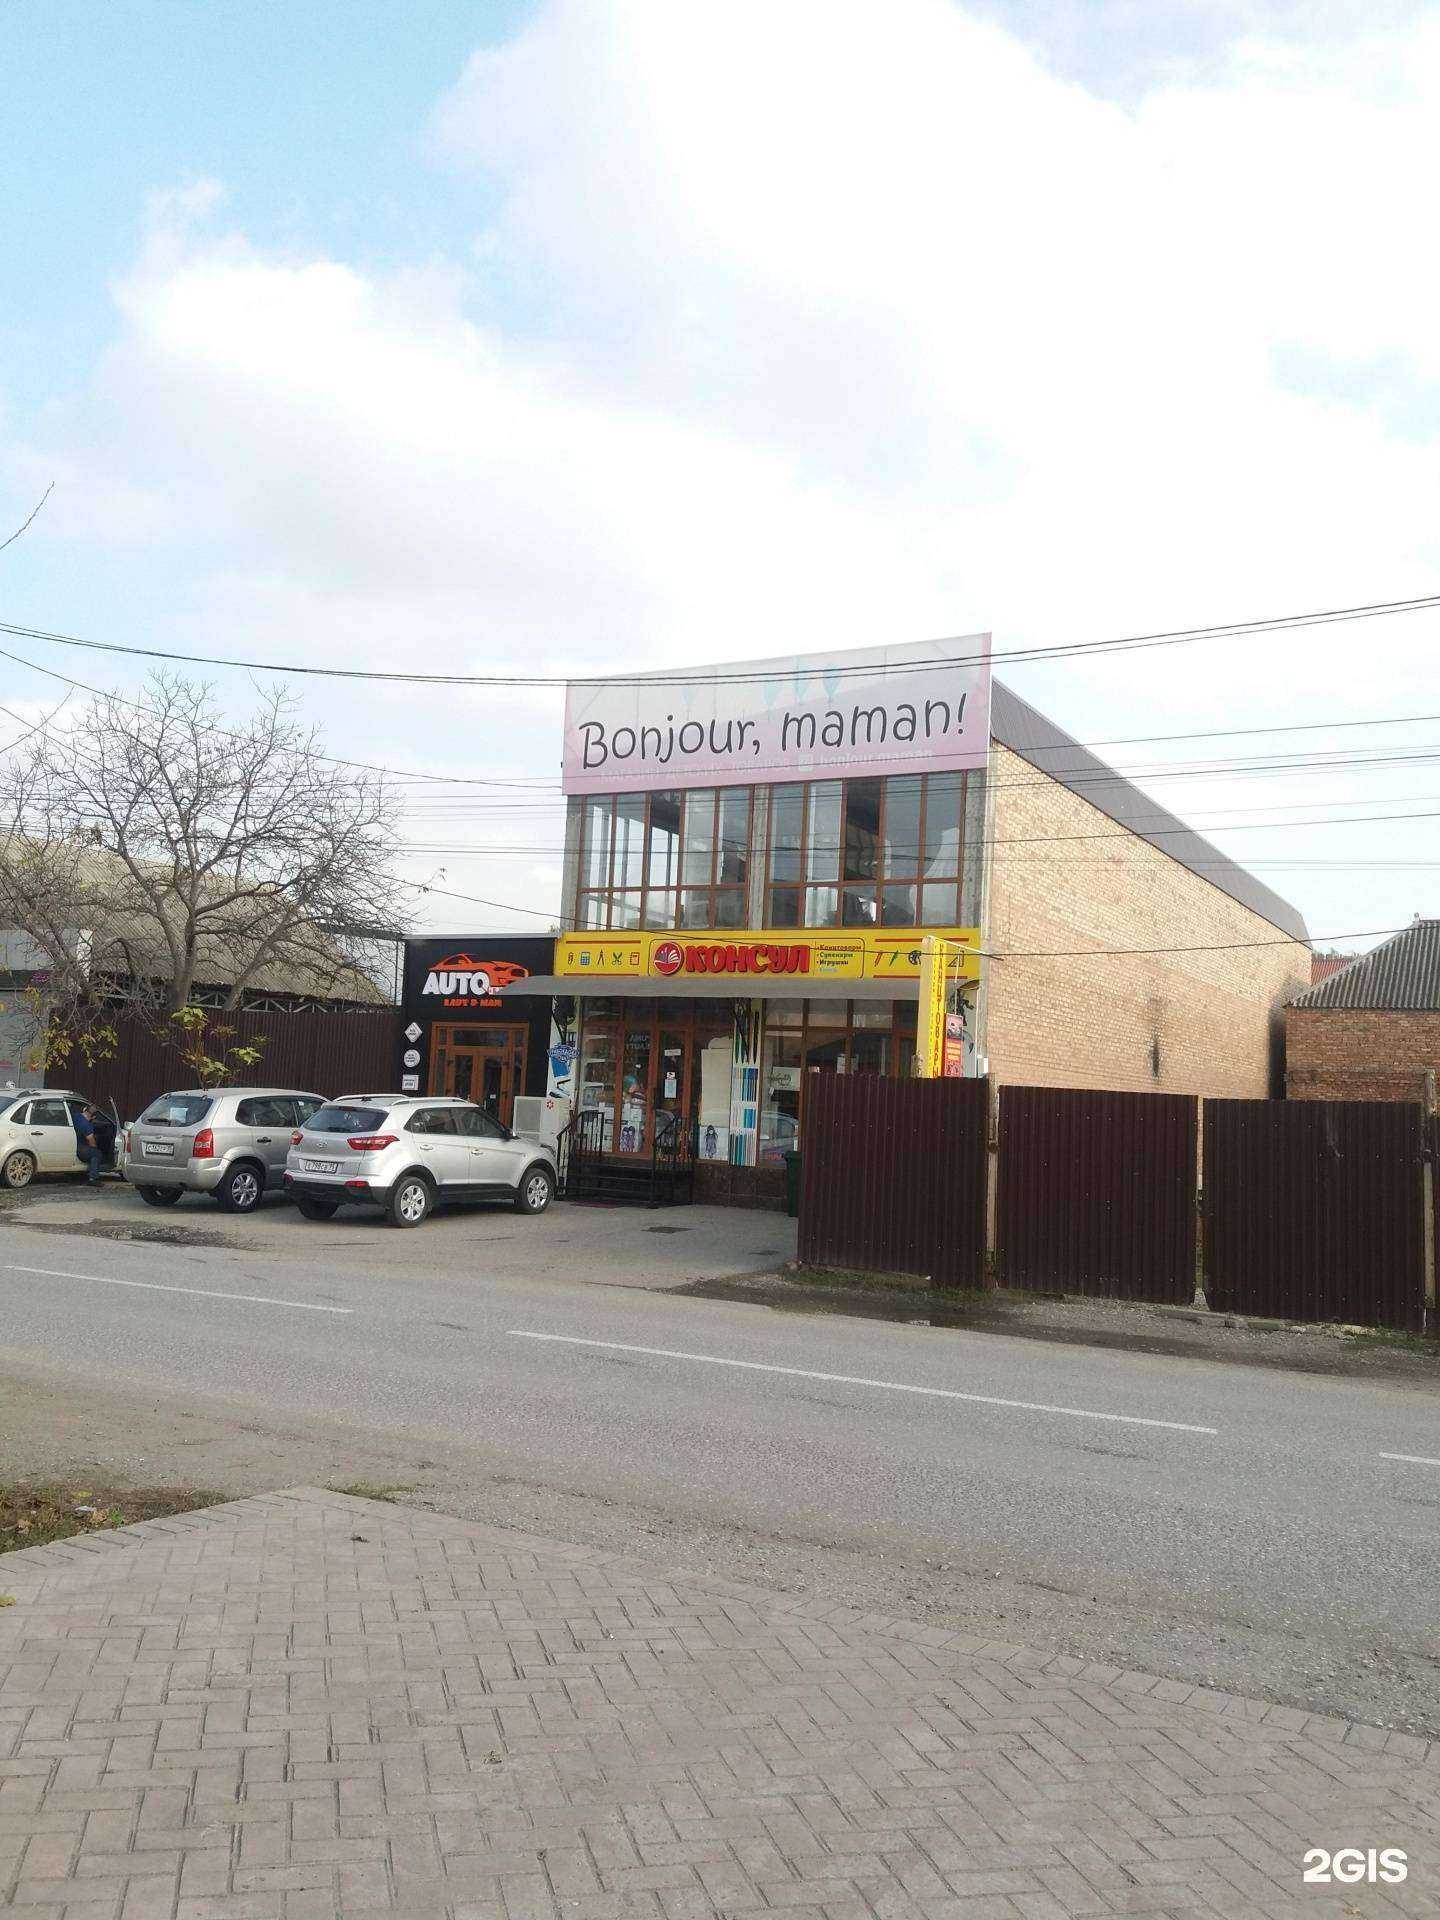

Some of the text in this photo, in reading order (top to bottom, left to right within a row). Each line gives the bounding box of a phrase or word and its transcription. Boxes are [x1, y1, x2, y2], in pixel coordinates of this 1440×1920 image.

[579, 692, 967, 770] Bonjour, maman!
[685, 944, 810, 973] КОНСУЛ
[422, 971, 490, 995] AUTO
